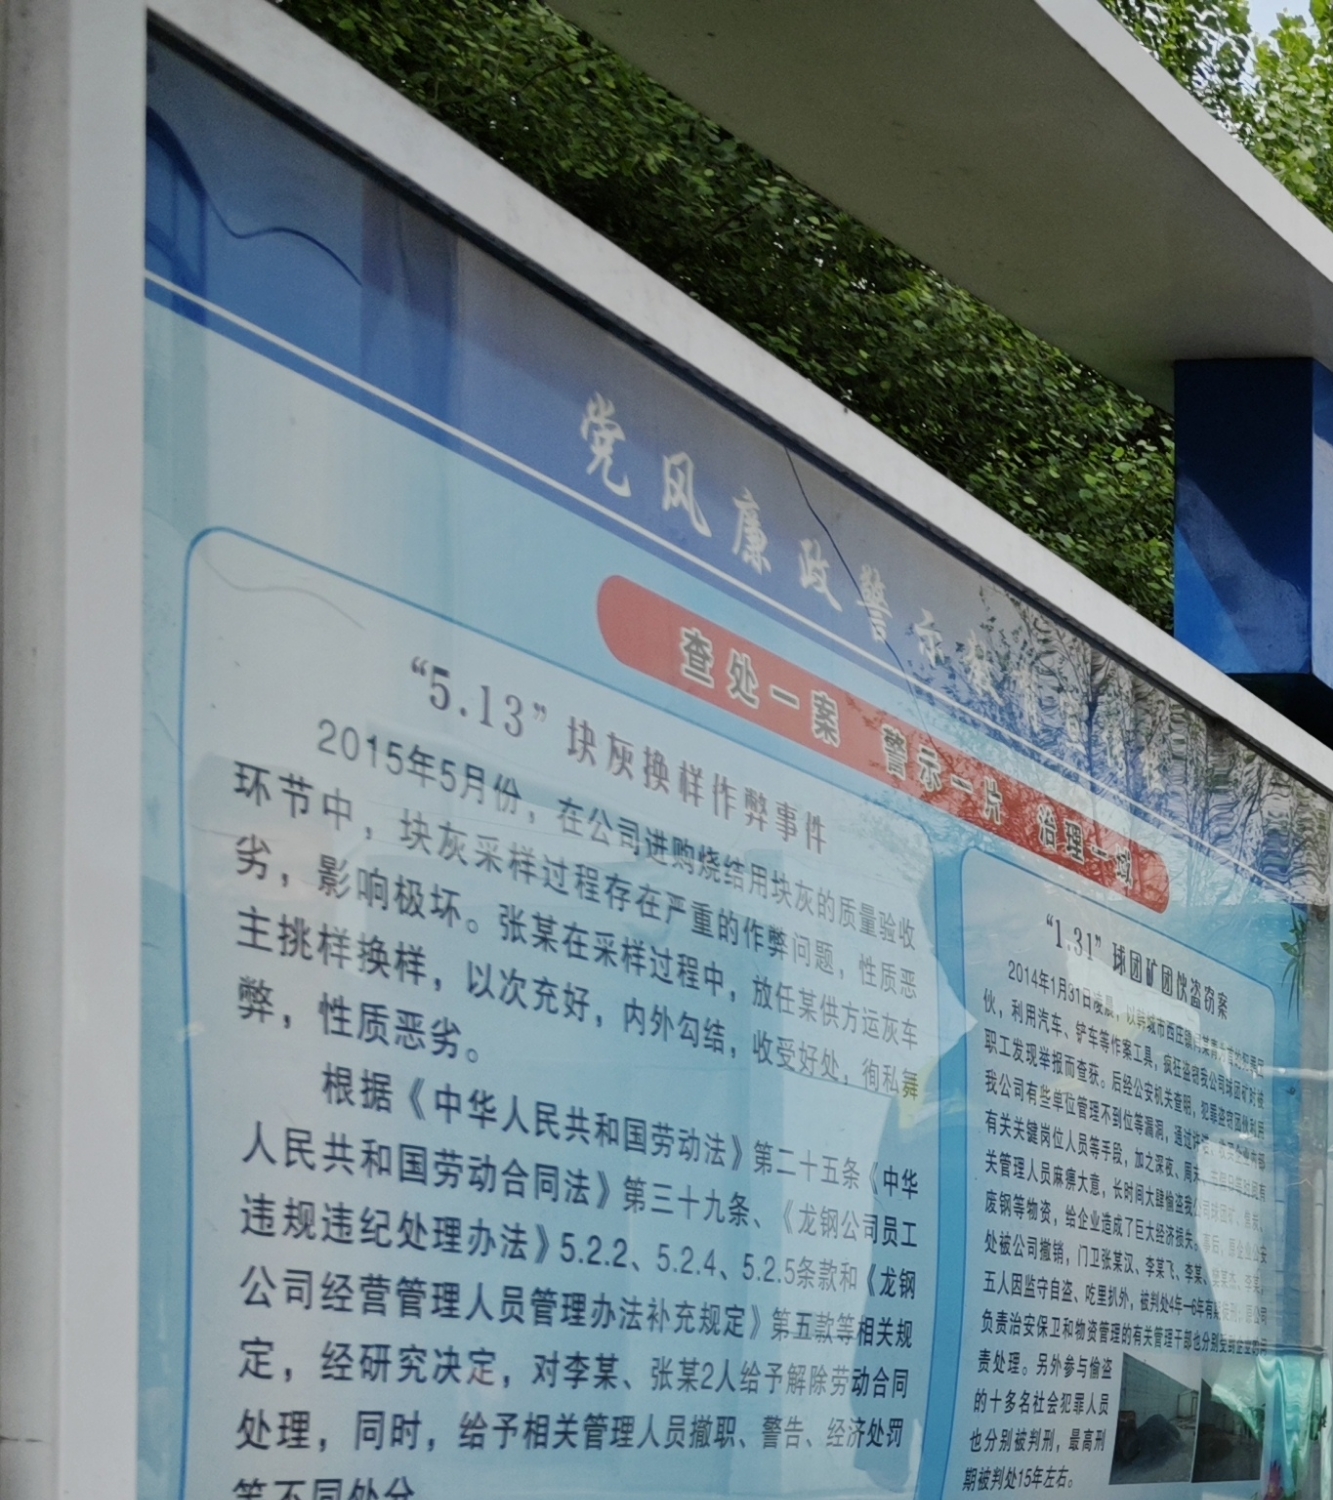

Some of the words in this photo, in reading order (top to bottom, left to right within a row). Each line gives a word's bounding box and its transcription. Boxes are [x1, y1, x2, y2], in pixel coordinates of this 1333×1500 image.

[411, 657, 547, 740] “5.13”
[567, 714, 828, 855] 块灰换样作弊事件
[679, 627, 841, 746] 查处一案
[880, 727, 1003, 825] 警示一片
[232, 758, 918, 1000] 环节中，块灰采样过程存在严重的作弊问题，性质恶
[235, 833, 919, 1050] 劣，影响极坏。张某在采样过程中，放任某供方运灰车
[1112, 941, 1229, 1021] 球团矿团伙盗窃案
[238, 976, 481, 1065] 弊，性质恶劣。
[322, 1062, 919, 1199] 根据《中华人民共和国劳动法》第二十五条《中华
[243, 1121, 918, 1252] 人民共和国劳动合同法》第三十九条、《龙钢公司员工
[239, 1263, 914, 1351] 公司经营管理人员管理办法补充规定》第五款等相关规
[237, 1335, 909, 1402] 定，经研究决定，对李某、张某2人给予解除劳动合同
[973, 1386, 1110, 1417] 的十多名社会犯罪人员
[977, 1350, 1113, 1380] 责处理。另外参与偷盗
[236, 1405, 904, 1454] 处理，同时，给予相关管理人员撤职、警告、经济处罚
[968, 1427, 1106, 1453] 也分别被判刑，最高刑
[962, 1464, 1074, 1492] 期被判处15年左右。
